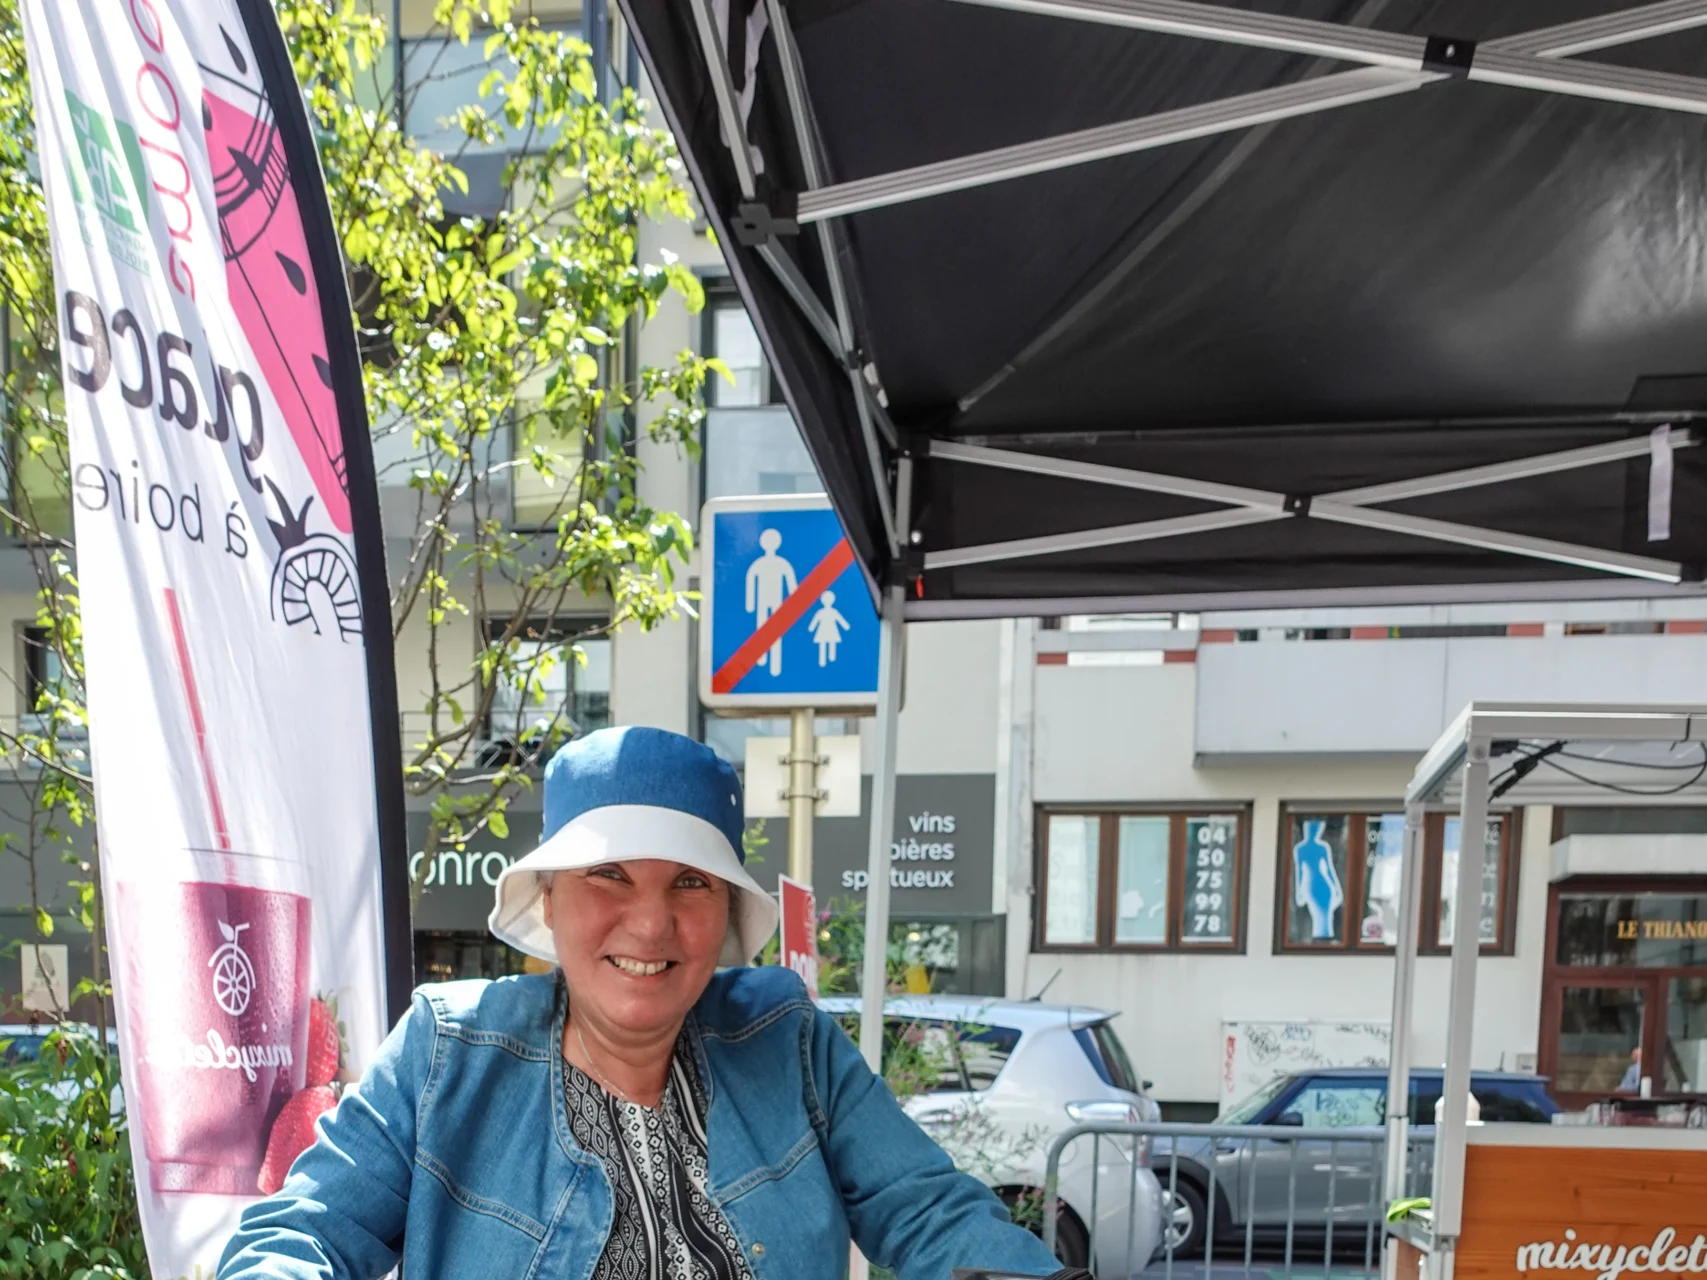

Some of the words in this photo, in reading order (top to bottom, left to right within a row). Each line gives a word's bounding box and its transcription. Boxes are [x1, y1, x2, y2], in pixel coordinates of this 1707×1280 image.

[908, 811, 956, 833] vins
[1197, 826, 1227, 845] 04
[1197, 849, 1226, 867] 50
[409, 851, 516, 887] onro
[841, 867, 955, 892] sptueux
[1196, 870, 1223, 889] 75
[1194, 892, 1223, 911] 99
[1194, 915, 1222, 933] 78
[1617, 920, 1639, 939] LE
